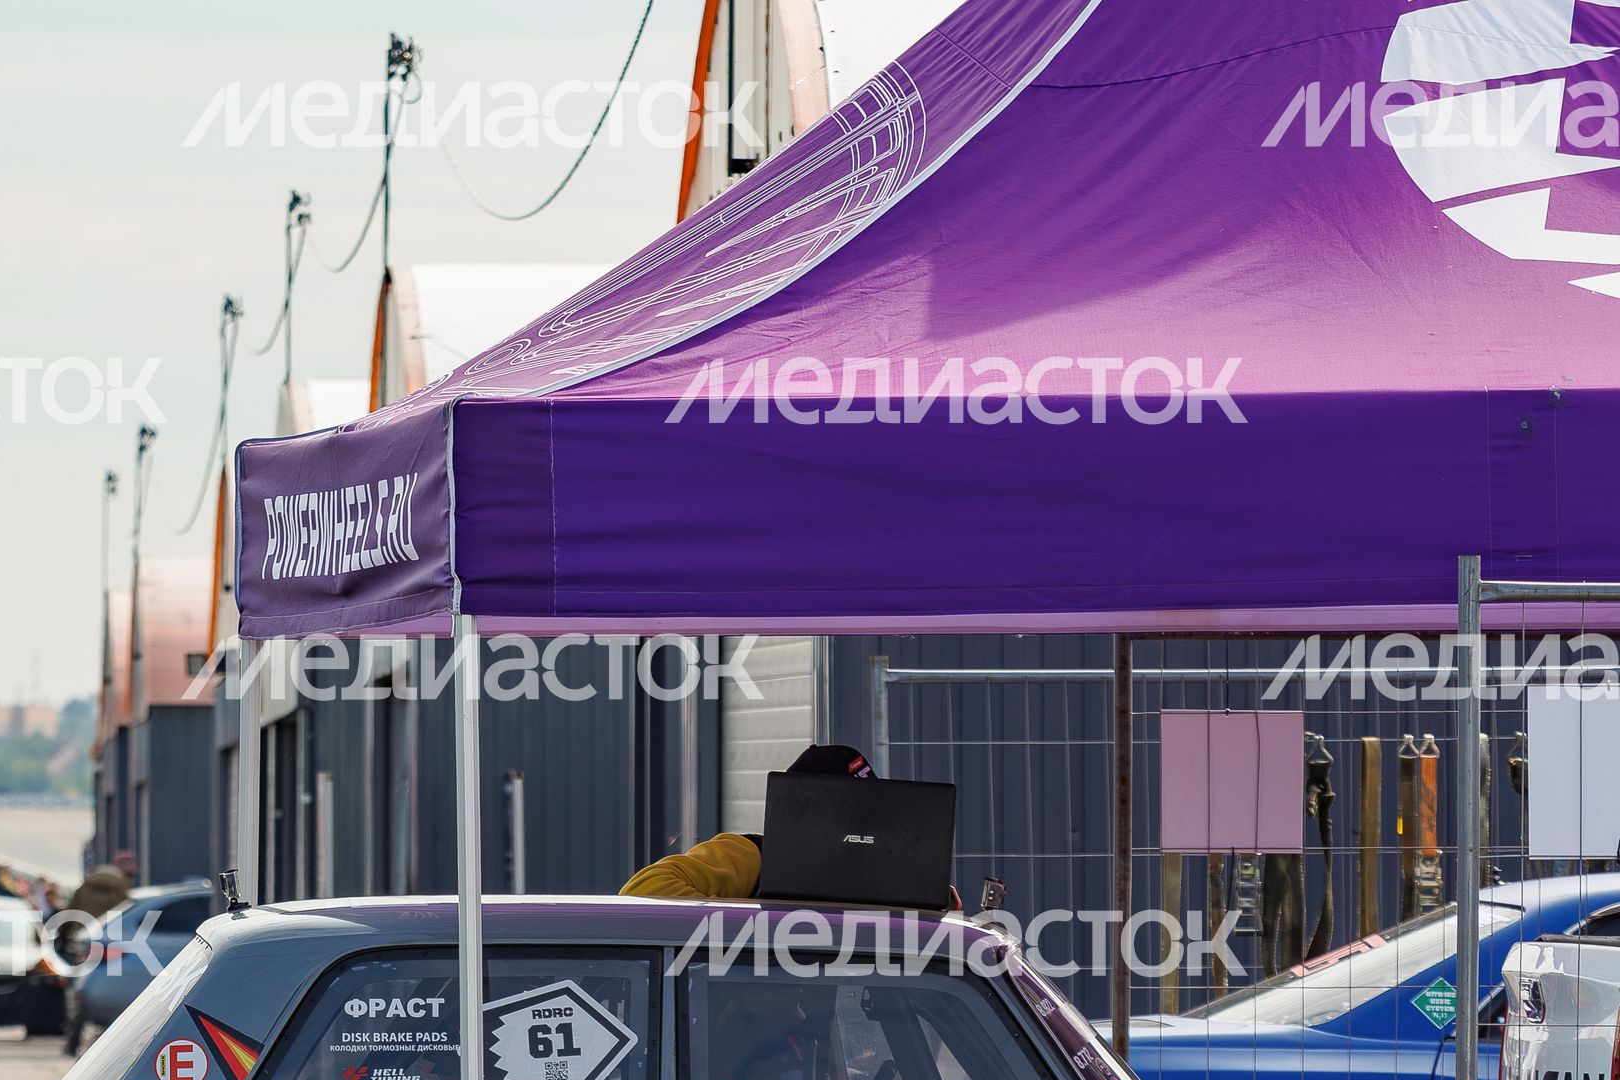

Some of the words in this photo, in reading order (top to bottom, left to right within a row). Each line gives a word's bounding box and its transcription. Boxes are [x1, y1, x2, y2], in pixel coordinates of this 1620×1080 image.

[261, 472, 419, 581] POWERWHEELS.RU
[843, 834, 875, 844] ASUS
[344, 998, 445, 1018] ФРАСТ
[531, 1007, 574, 1019] RDRC
[342, 1033, 370, 1042] DISK
[373, 1033, 413, 1042] BRAKE
[416, 1032, 448, 1042] PADS
[527, 1022, 581, 1059] 61
[330, 1045, 367, 1053] КОЛОДКИ
[373, 1069, 405, 1077] HELL
